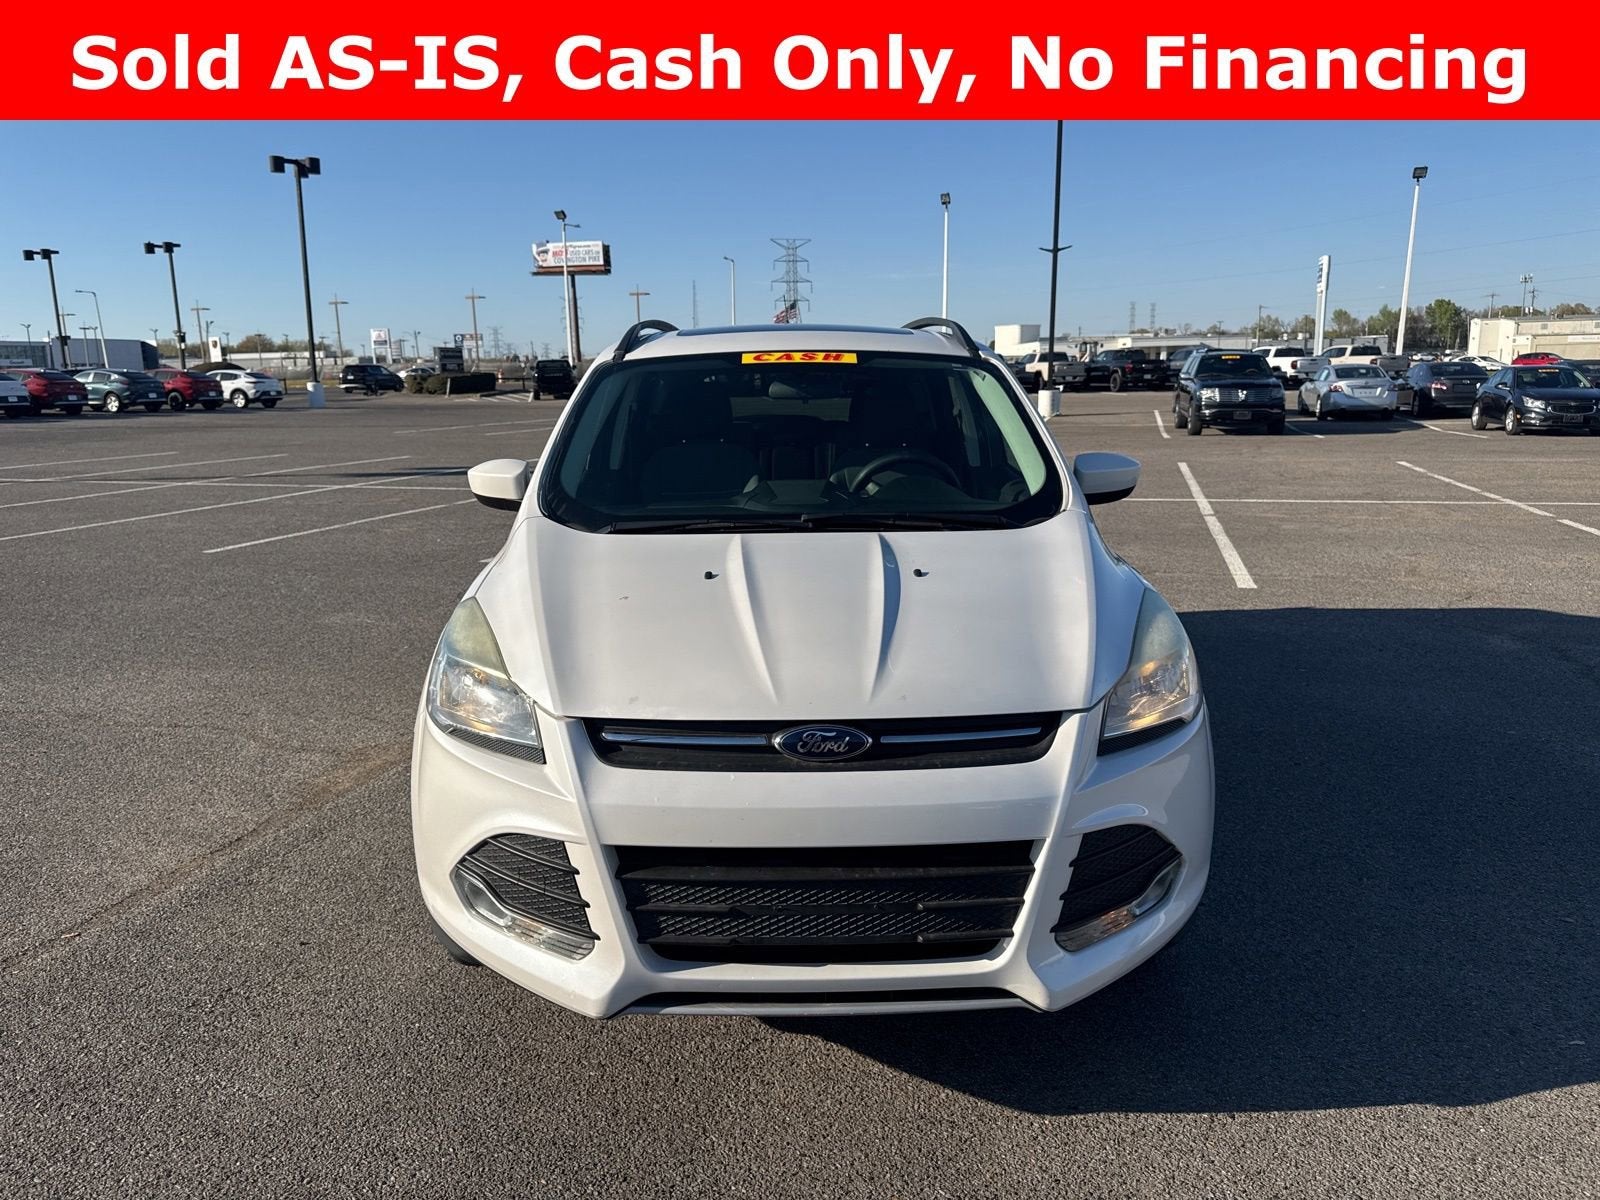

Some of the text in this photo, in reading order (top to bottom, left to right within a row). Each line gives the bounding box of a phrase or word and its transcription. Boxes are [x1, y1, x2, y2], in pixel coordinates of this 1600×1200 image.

[553, 256, 587, 264] COVNGTON
[752, 352, 845, 361] CASH
[797, 730, 850, 753] Ford
